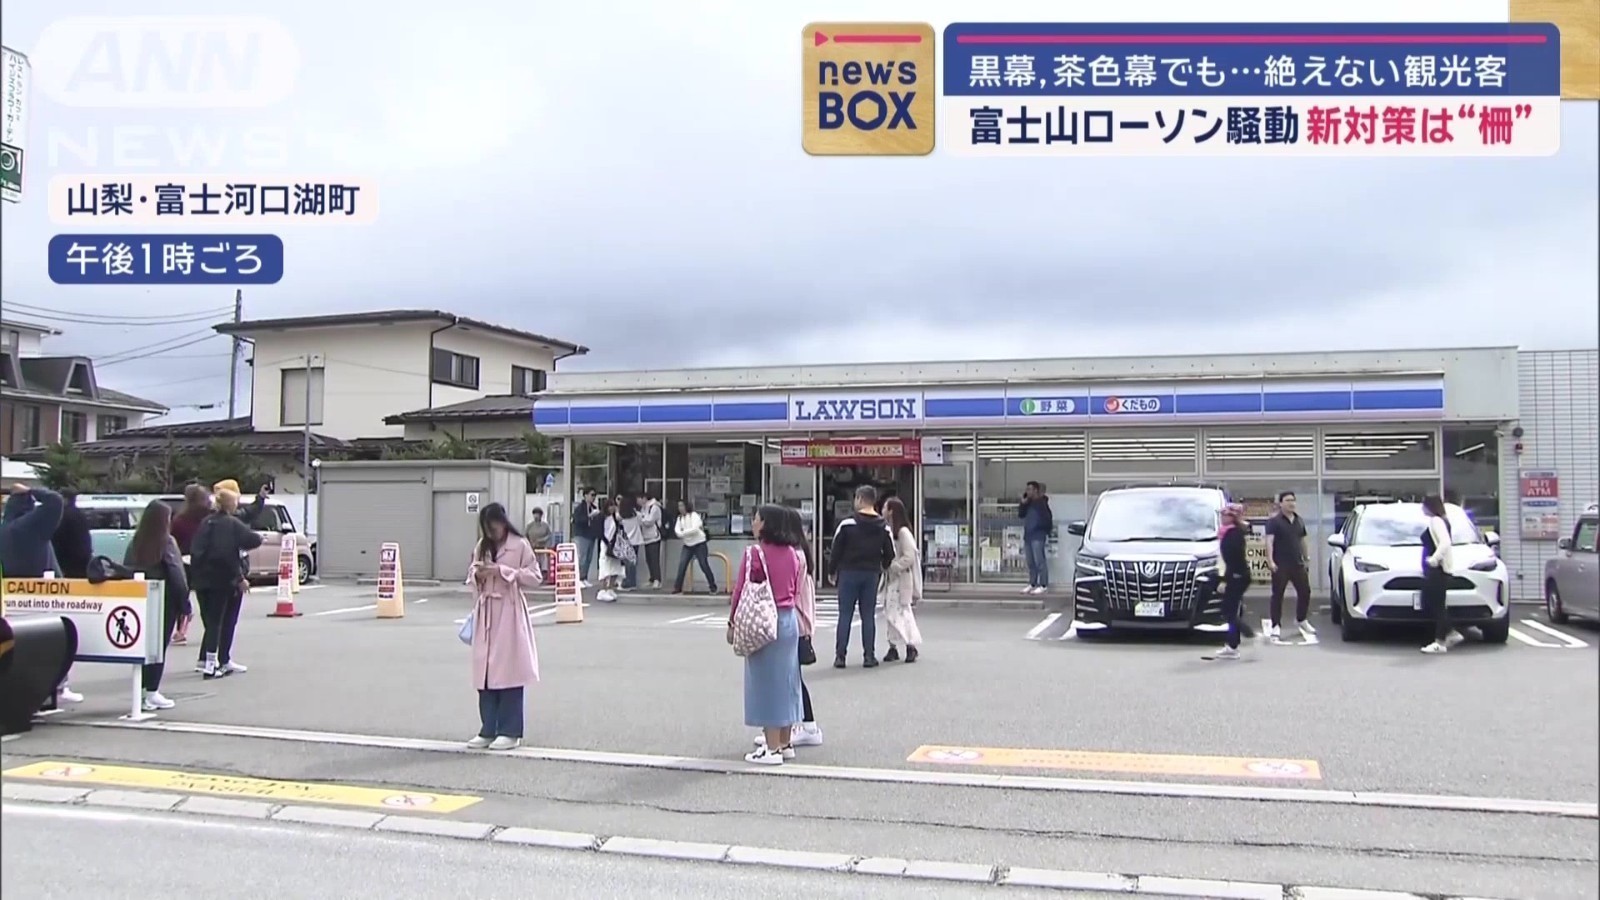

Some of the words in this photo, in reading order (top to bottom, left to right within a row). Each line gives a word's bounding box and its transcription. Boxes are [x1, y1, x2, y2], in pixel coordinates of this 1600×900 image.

[795, 398, 917, 421] LAWSON
[1039, 399, 1068, 412] 野菜
[1121, 399, 1158, 411] くだもの
[1527, 487, 1551, 496] ATM
[7, 581, 70, 595] CAUTION
[18, 599, 32, 608] out
[33, 598, 50, 609] into
[51, 599, 66, 609] the
[67, 600, 103, 612] roadway
